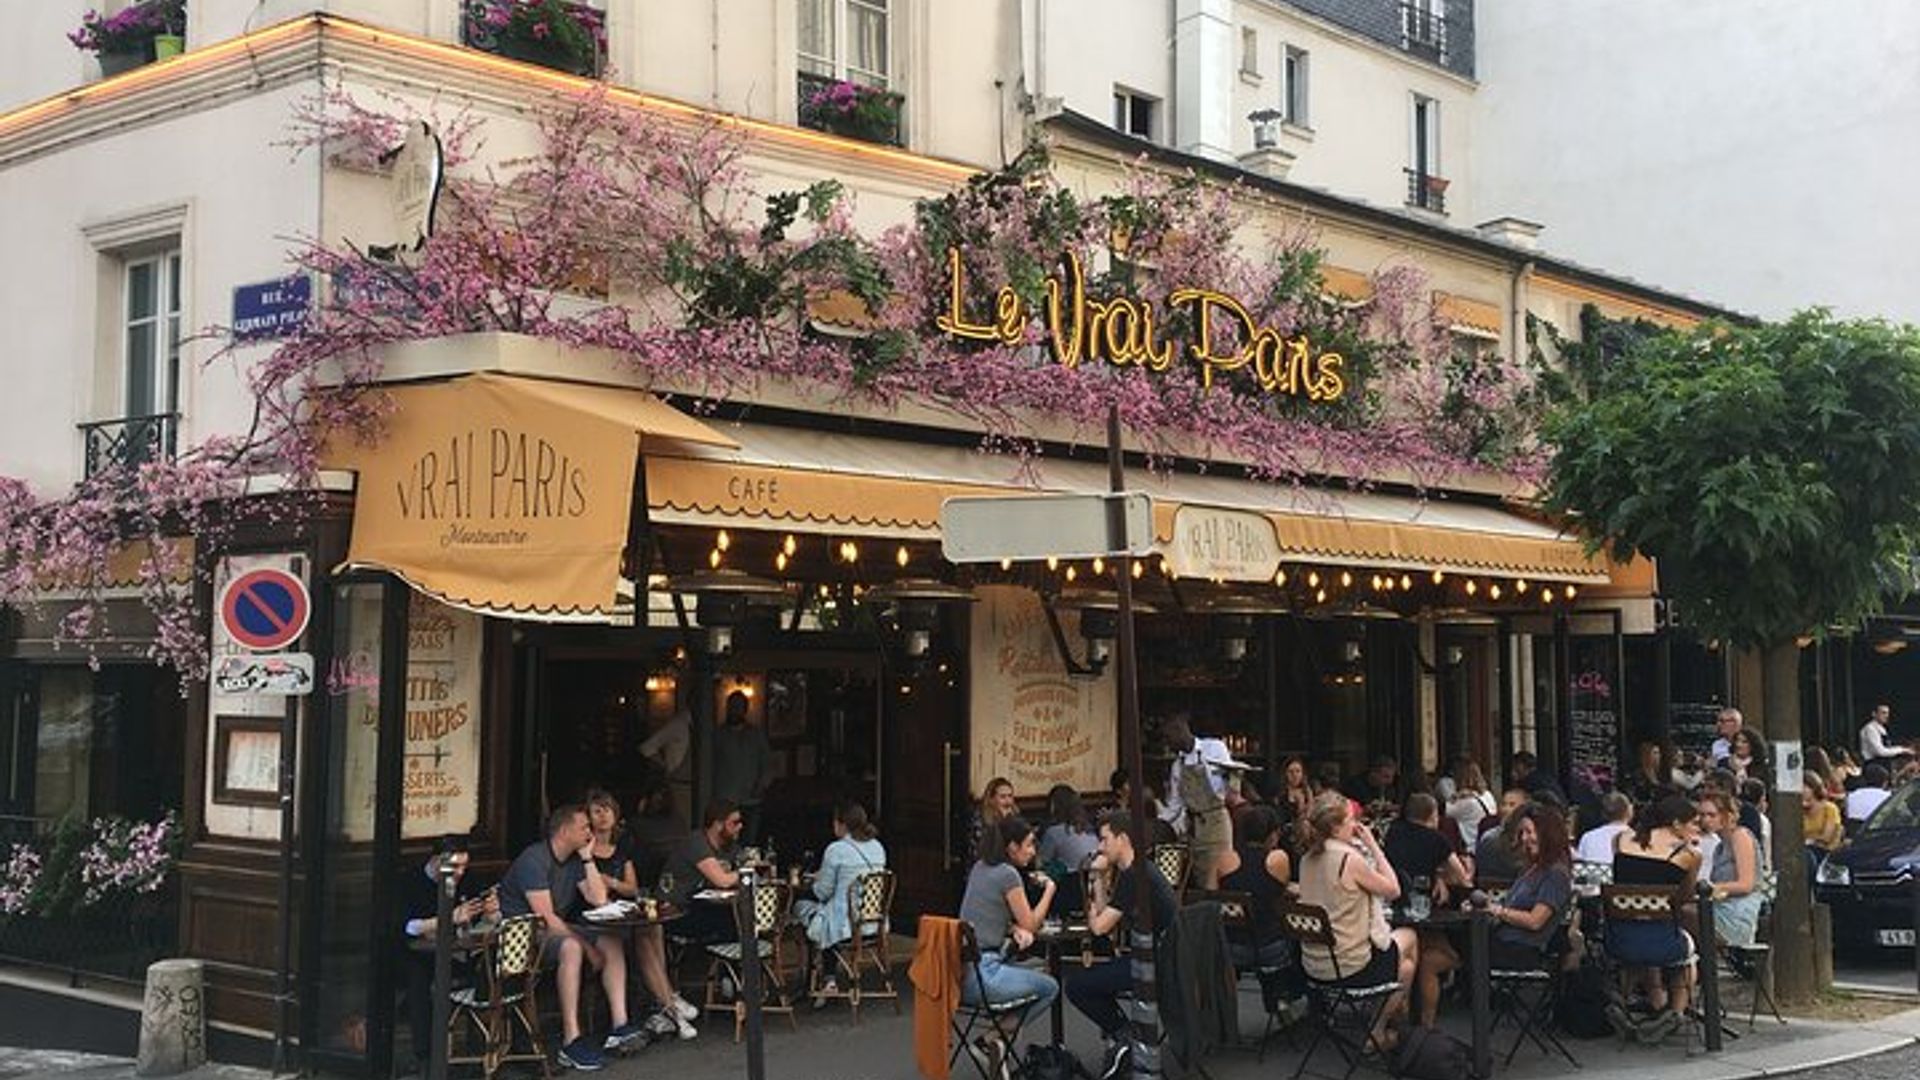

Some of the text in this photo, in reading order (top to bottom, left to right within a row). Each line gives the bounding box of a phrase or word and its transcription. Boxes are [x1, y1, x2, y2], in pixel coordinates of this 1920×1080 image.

[261, 291, 283, 305] RUE
[280, 309, 309, 326] PILO
[935, 246, 1344, 401] Le Vrai Paris
[396, 427, 587, 520] VRAI PARIS
[440, 524, 528, 548] Montmartre
